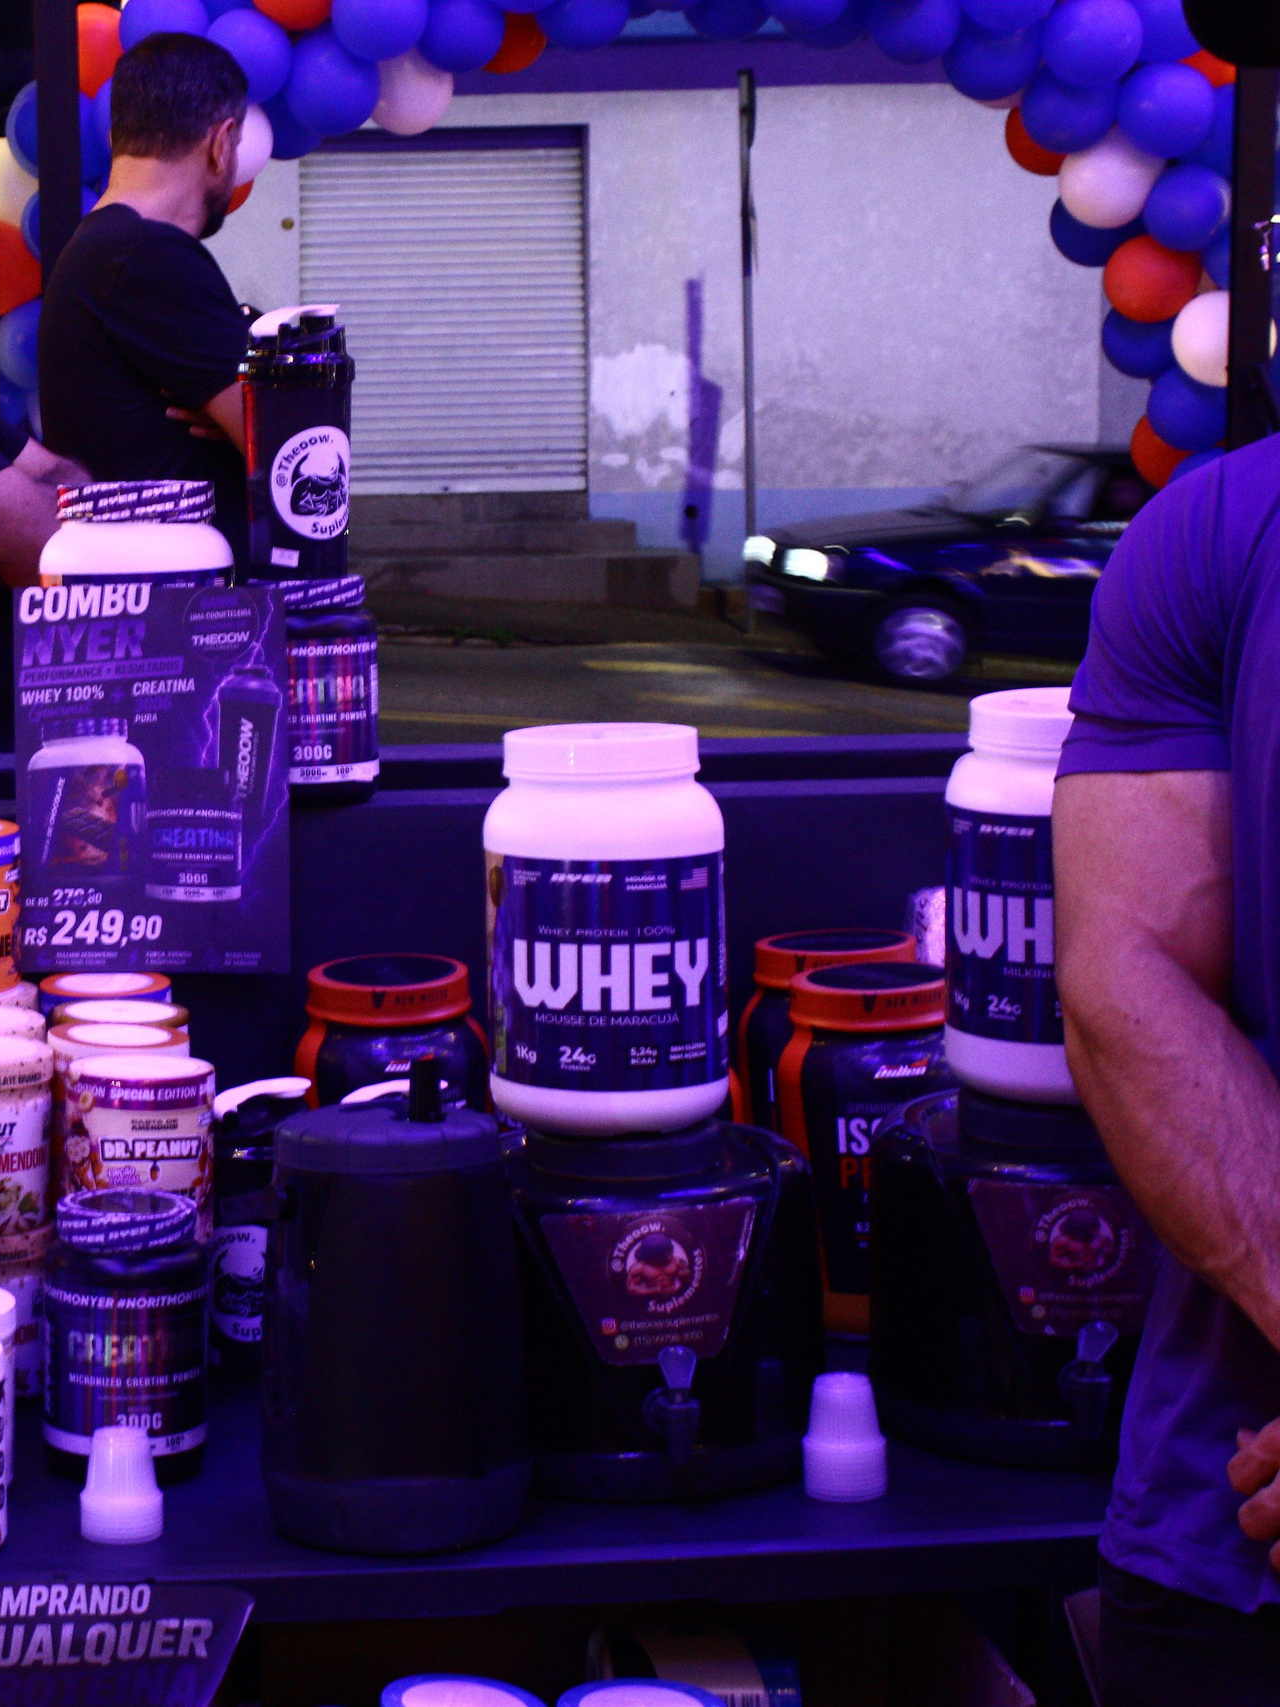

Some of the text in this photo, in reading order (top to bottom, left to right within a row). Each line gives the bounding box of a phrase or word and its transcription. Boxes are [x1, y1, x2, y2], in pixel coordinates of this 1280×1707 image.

[19, 582, 152, 624] COMBO
[22, 617, 146, 667] NYER
[23, 667, 103, 683] PERFORMANCE
[21, 684, 105, 706] WHEY 100%
[132, 677, 196, 697] CREATINA
[134, 713, 158, 724] PURA
[23, 909, 163, 948] R$ 249,90
[538, 923, 676, 937] WHEY PROTEIN 100%
[953, 886, 1054, 965] WH
[513, 937, 709, 1013] WHEY
[535, 1012, 605, 1028] MOUSSE DE
[515, 1043, 537, 1065] 1Kg
[109, 1086, 197, 1100] SPECIAL EDITION
[103, 1139, 200, 1159] DR. PEANUT
[126, 1374, 169, 1388] CREATINE
